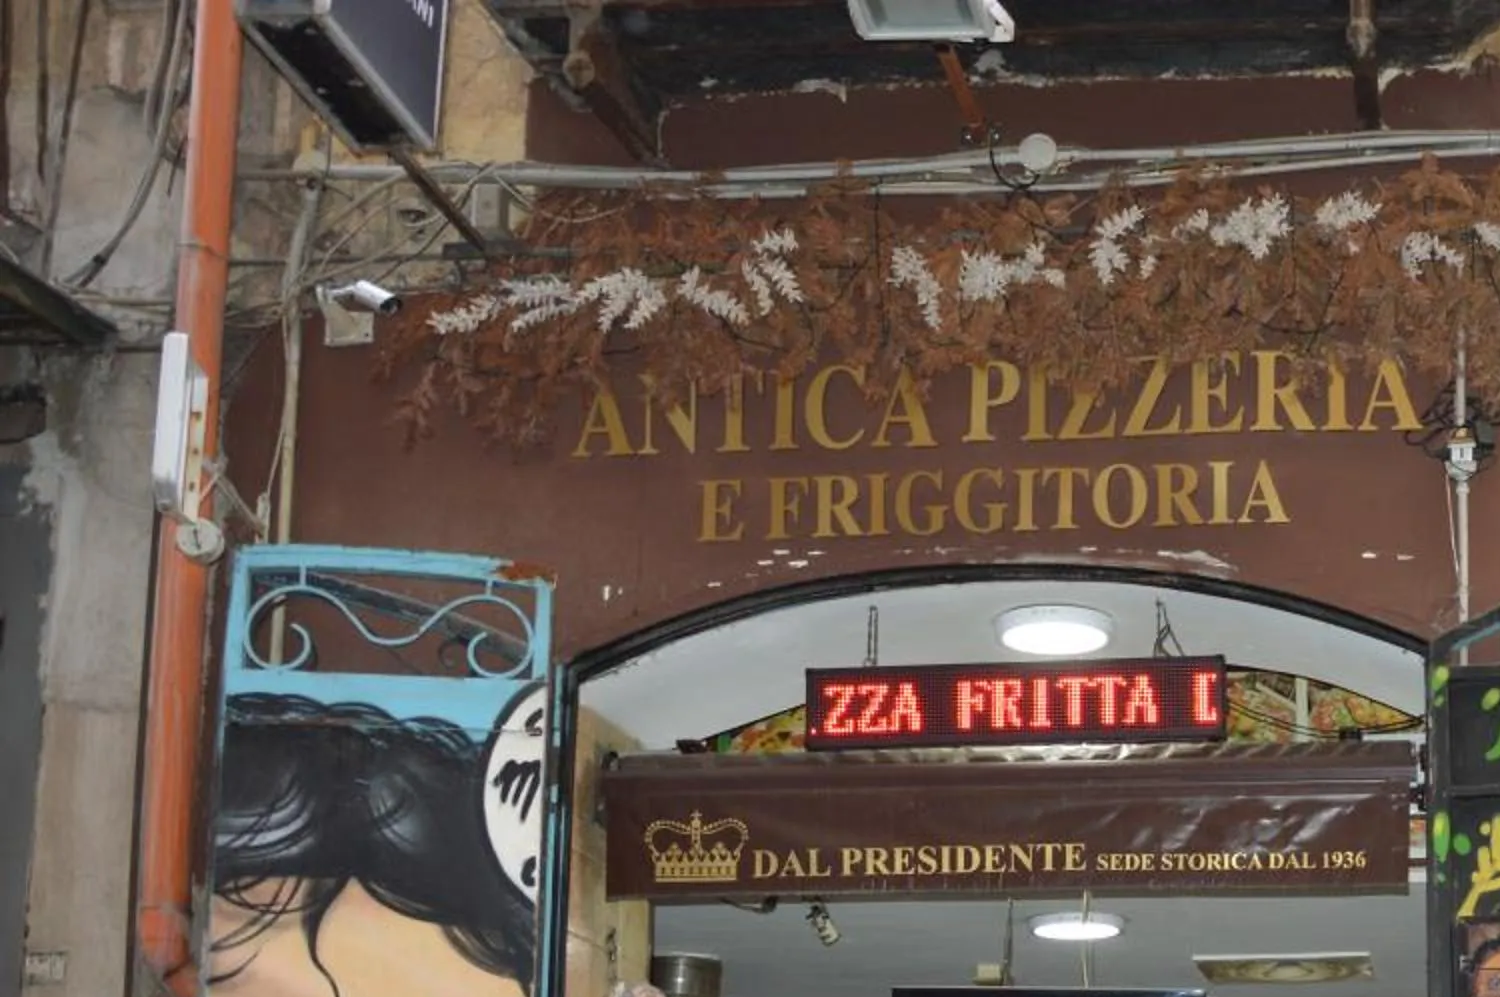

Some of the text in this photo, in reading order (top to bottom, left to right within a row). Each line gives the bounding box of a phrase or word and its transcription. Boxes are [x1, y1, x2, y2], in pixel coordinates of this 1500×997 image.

[571, 350, 1425, 458] ANTICA PIZZERIA
[697, 459, 1292, 543] E FRIGGITORIA
[822, 683, 923, 735] ZZA
[955, 674, 1158, 731] FRITTA
[752, 843, 1368, 880] DAL PRESIDENTE SEDE STORICA DAL 1936
